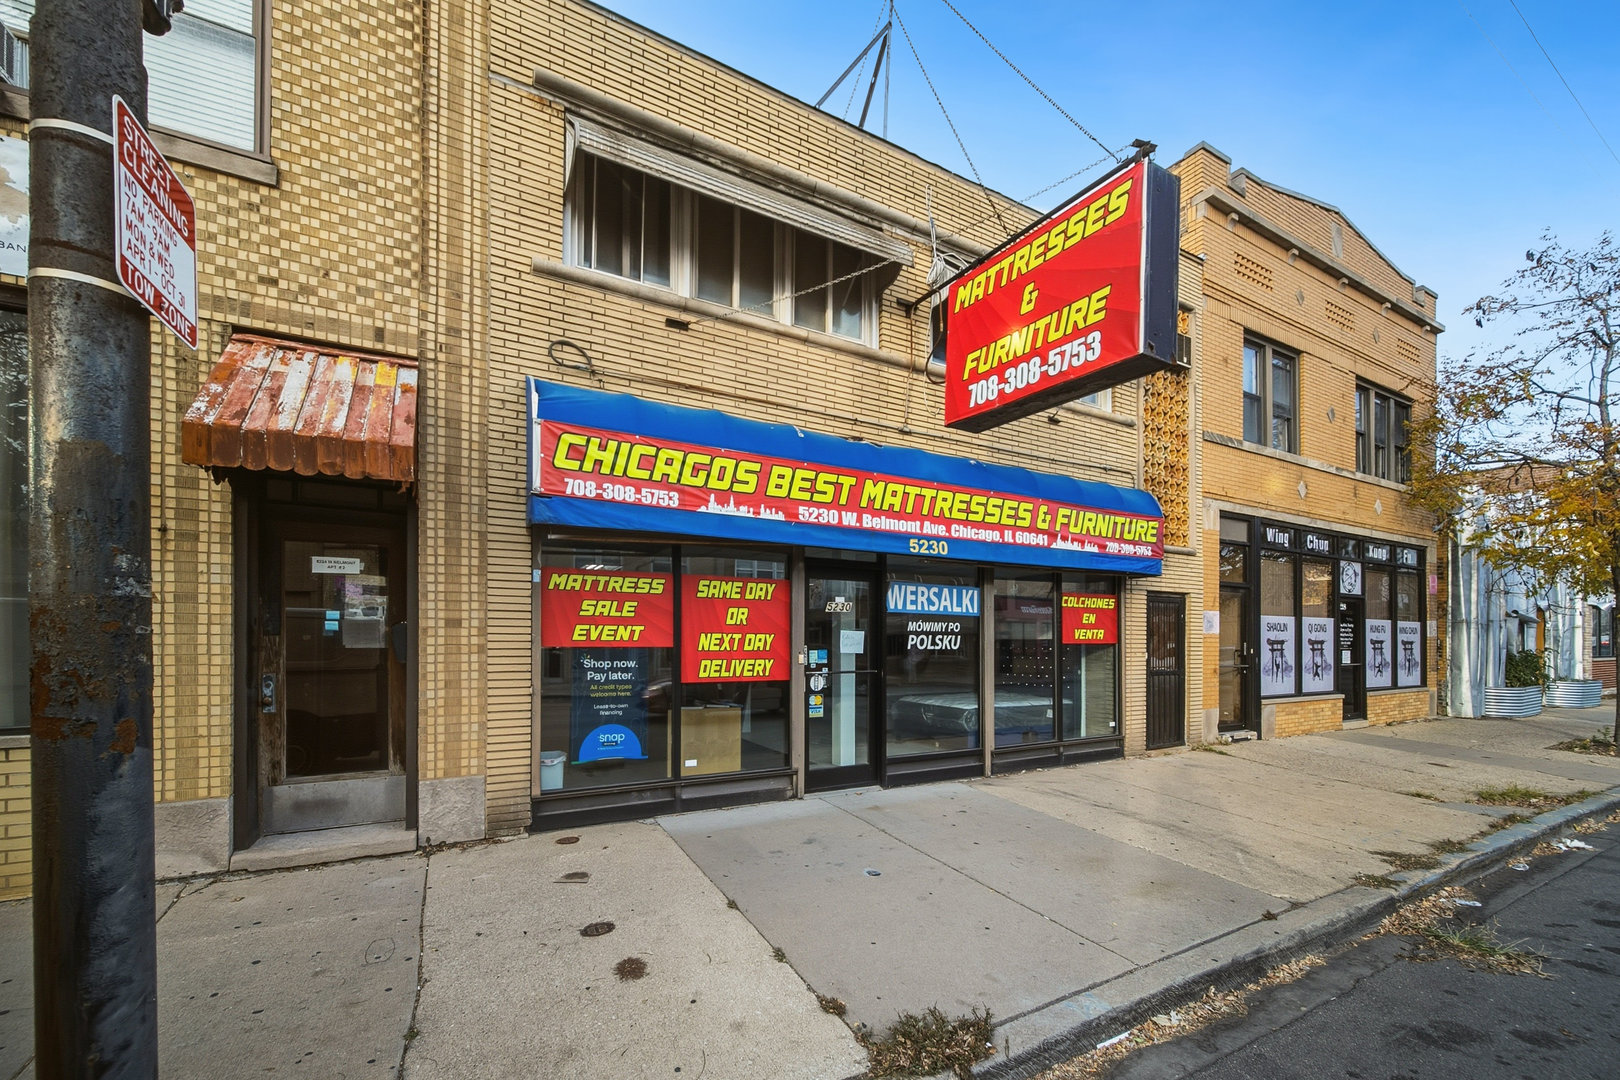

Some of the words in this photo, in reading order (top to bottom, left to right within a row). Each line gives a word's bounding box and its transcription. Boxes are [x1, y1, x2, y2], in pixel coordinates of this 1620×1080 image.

[124, 116, 172, 192] STREET
[123, 141, 189, 237] CLEANING
[124, 171, 137, 198] NO
[143, 194, 177, 247] PARKING
[125, 191, 144, 228] 7AM
[153, 226, 170, 257] 9AM
[126, 214, 146, 250] MON
[149, 242, 155, 260] &
[158, 250, 174, 279] WED
[953, 178, 1133, 314] MATTRESSES
[127, 238, 145, 269] APR
[148, 259, 151, 275] 1
[161, 273, 176, 299] OCT
[178, 291, 185, 309] 31
[126, 260, 155, 305] TOW
[161, 297, 192, 342] ZONE
[1020, 282, 1039, 316] &
[962, 283, 1112, 381] FURNITURE
[968, 330, 1102, 408] 708-308-5753
[552, 432, 761, 494] CHICAGOS
[765, 464, 857, 506] BEST
[859, 478, 1034, 528] MATTRESSES
[1036, 504, 1051, 530] &
[1055, 507, 1159, 543] FURNITURE
[564, 478, 679, 507] 708-308-5753
[798, 505, 838, 524] 5230
[841, 511, 860, 527] W.
[862, 513, 921, 534] Belmont
[922, 521, 949, 536] Ave.
[951, 523, 1002, 543] Chicago,
[1004, 530, 1013, 542] IL
[1015, 531, 1048, 546] 60641
[909, 538, 948, 555] 5230
[1266, 528, 1289, 547] Wing
[1368, 545, 1387, 560] Kung
[1403, 550, 1412, 563] Fu
[547, 573, 666, 594] MATTRESS
[696, 579, 743, 599] SAME
[744, 582, 776, 600] DAY
[578, 599, 638, 617] SALE
[826, 602, 851, 611] 5230
[888, 584, 978, 613] WERSALKI
[1061, 596, 1115, 609] COLCHONES
[726, 607, 749, 625] OR
[907, 619, 948, 632] MÓWIMY
[948, 622, 960, 632] PO
[1082, 613, 1096, 624] EN
[572, 624, 645, 641] EVENT
[1074, 629, 1104, 640] VENTA
[1266, 622, 1288, 633] SHAOLIN
[1314, 624, 1327, 633] GONG
[698, 632, 742, 651] NEXT
[743, 633, 775, 651] DAY
[907, 634, 961, 650] POLSKU
[583, 659, 611, 670] Shop
[698, 659, 774, 678] DELIVERY
[587, 671, 606, 682] Pay
[608, 671, 635, 680] later.
[599, 732, 625, 743] snap
